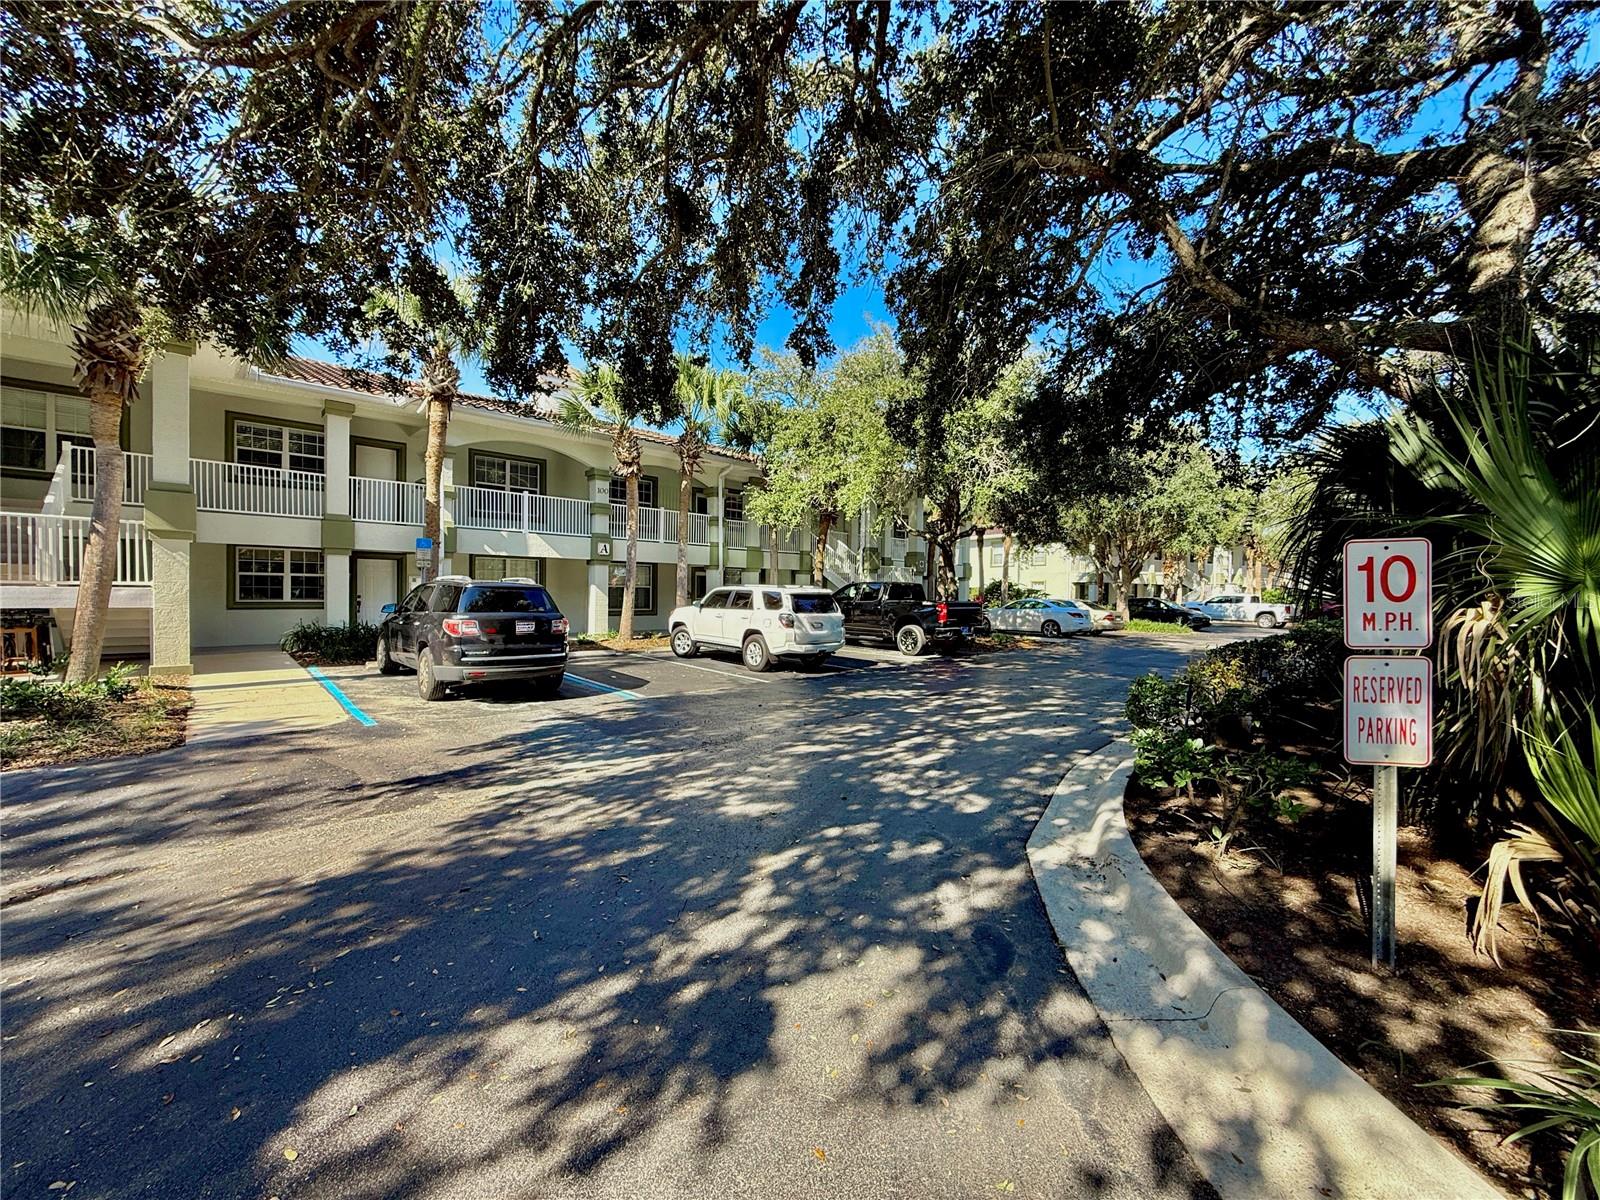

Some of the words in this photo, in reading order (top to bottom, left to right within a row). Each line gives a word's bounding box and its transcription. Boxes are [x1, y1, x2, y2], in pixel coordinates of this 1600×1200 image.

[597, 487, 609, 495] 100
[600, 544, 609, 554] A
[1357, 554, 1417, 603] 10
[1353, 676, 1422, 705] RESERVED
[1358, 716, 1417, 746] PARKING
